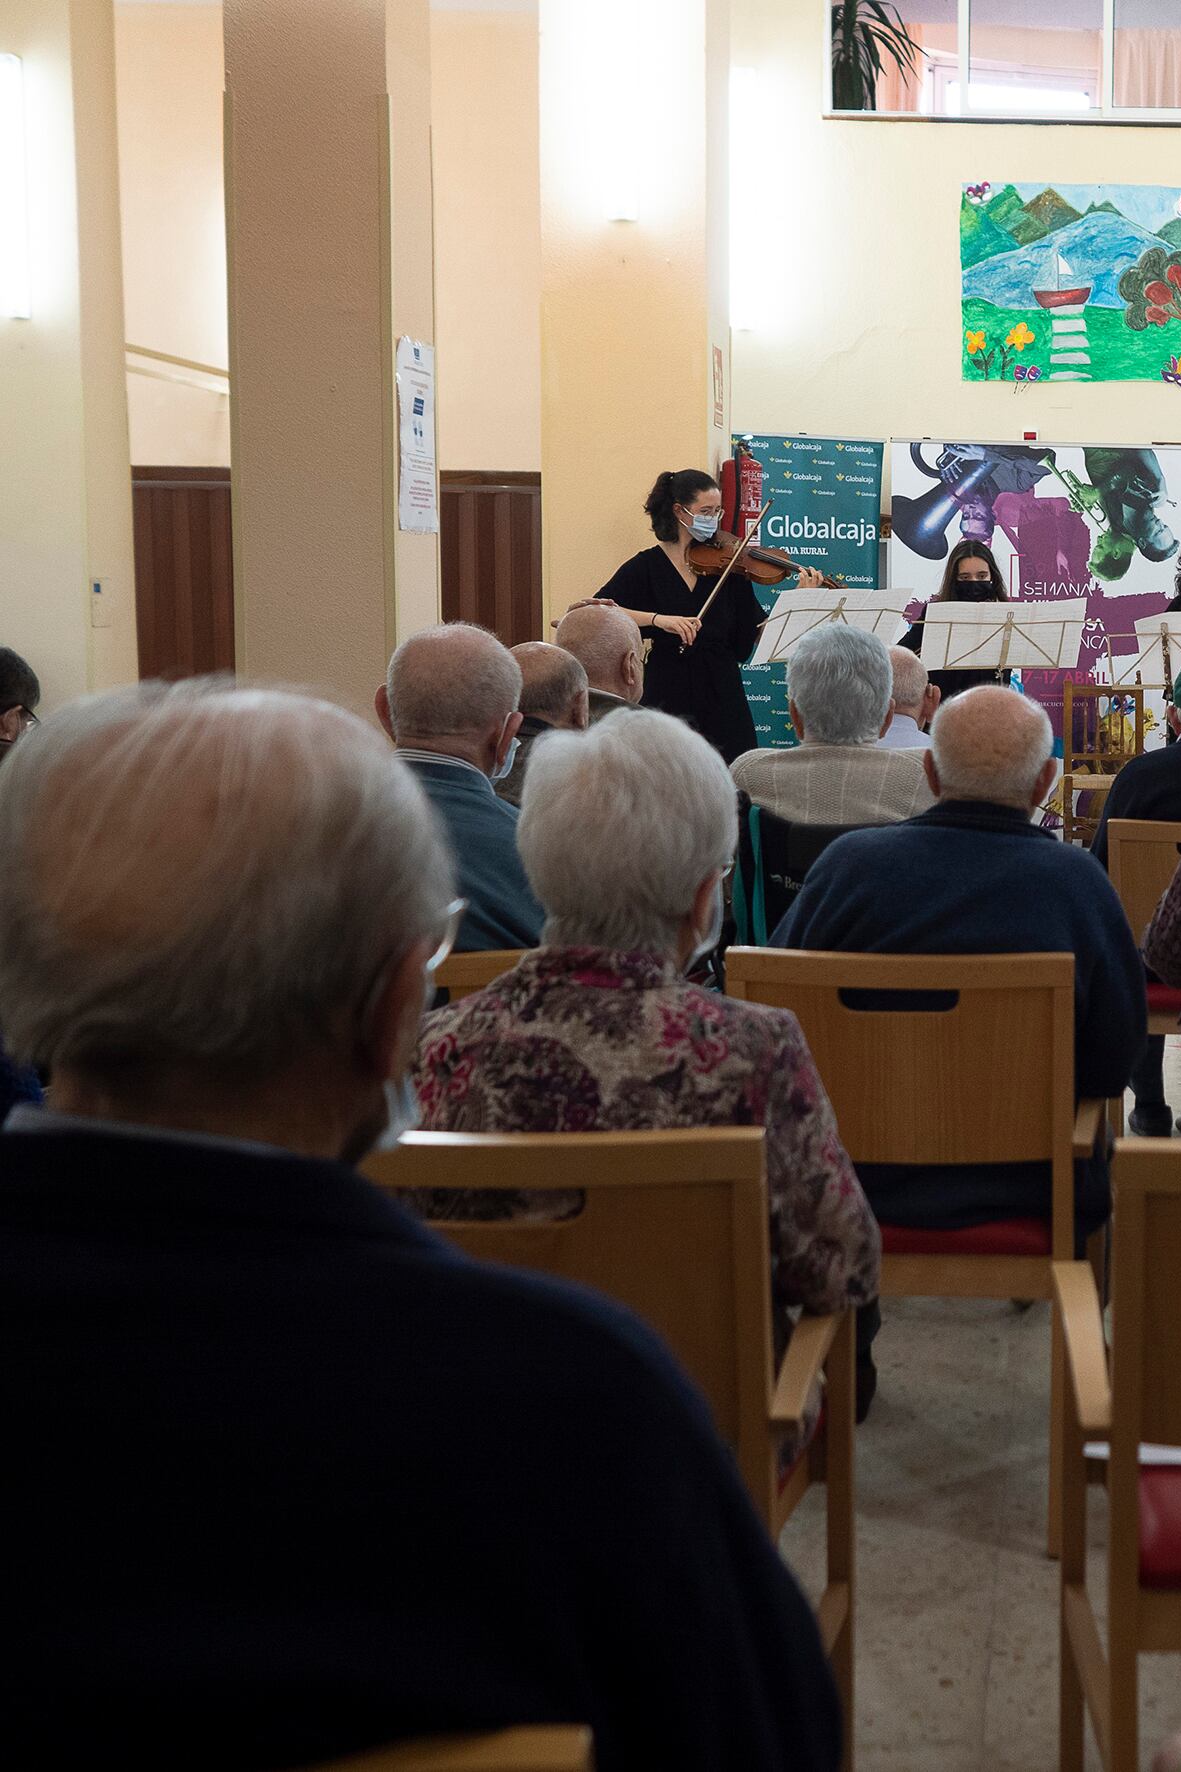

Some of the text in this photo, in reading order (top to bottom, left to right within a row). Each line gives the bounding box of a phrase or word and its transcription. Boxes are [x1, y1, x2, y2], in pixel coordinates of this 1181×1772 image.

[792, 442, 822, 451] Globalcaja
[845, 445, 874, 454] Globalcaja
[792, 472, 822, 482] Globalcaja
[845, 475, 874, 484] Globalcaja
[767, 514, 876, 547] Globalcaja
[800, 547, 829, 556] RURAL
[845, 574, 874, 584] Globalcaja
[1024, 582, 1093, 596] SEMANA
[1081, 635, 1109, 649] NCA
[1063, 671, 1110, 685] ABRIL
[755, 724, 771, 733] alcaja
